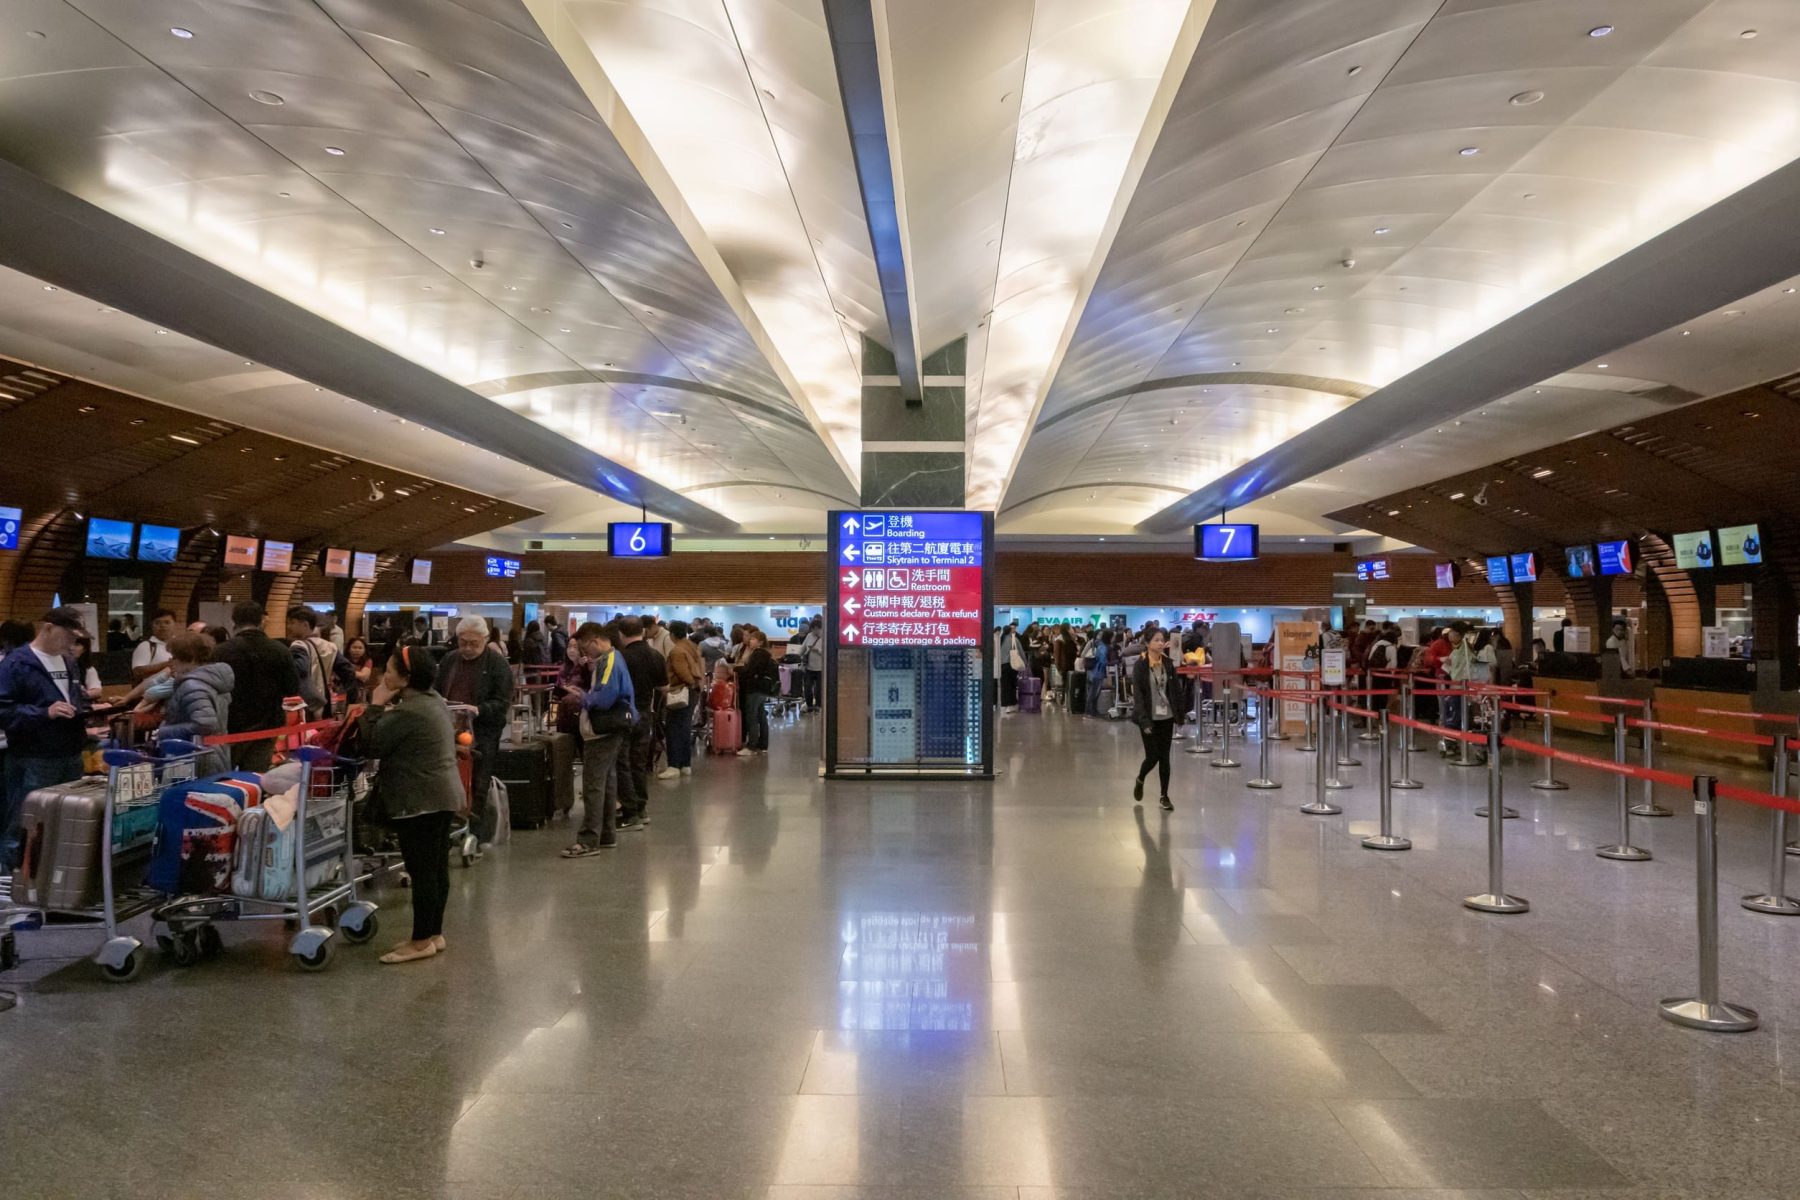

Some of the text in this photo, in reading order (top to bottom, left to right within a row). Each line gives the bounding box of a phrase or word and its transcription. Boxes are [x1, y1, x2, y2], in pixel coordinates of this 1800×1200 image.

[888, 515, 912, 528] 登機
[629, 527, 646, 552] 6
[887, 529, 925, 539] Boarding
[1219, 528, 1235, 554] 7
[887, 542, 974, 555] 往第二航廈電車
[887, 555, 974, 565] Skytrain to Terminal 2
[911, 569, 950, 582] 洗手間
[911, 582, 951, 591] Restroom
[863, 609, 978, 618] Customs declare / Tax refund
[1182, 613, 1218, 621] FAT
[862, 622, 950, 635] 行李寄存及打包
[862, 636, 976, 646] Baggage storage & packing
